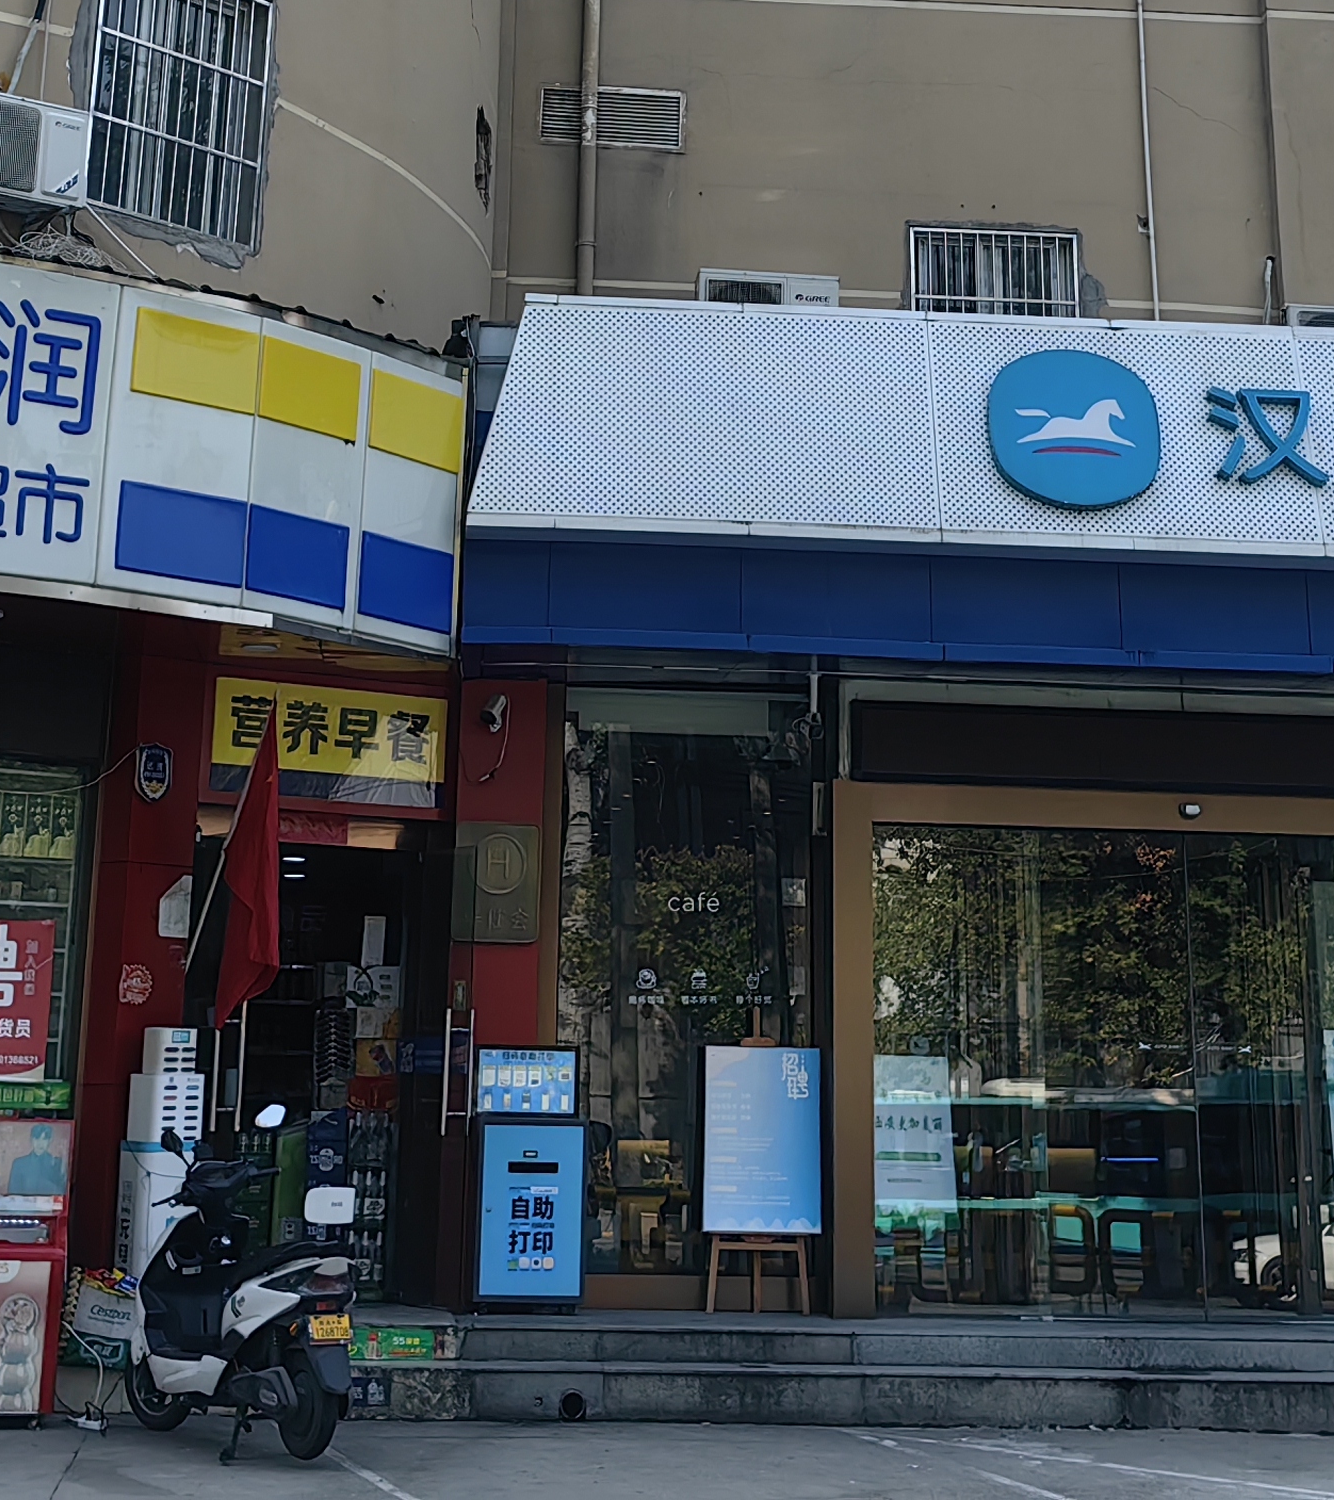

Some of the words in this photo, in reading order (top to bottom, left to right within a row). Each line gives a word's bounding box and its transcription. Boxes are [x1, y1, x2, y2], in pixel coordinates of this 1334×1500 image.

[231, 695, 431, 764] 营养早餐
[667, 891, 720, 912] café
[511, 1195, 554, 1220] 自助
[508, 1230, 554, 1255] 打印
